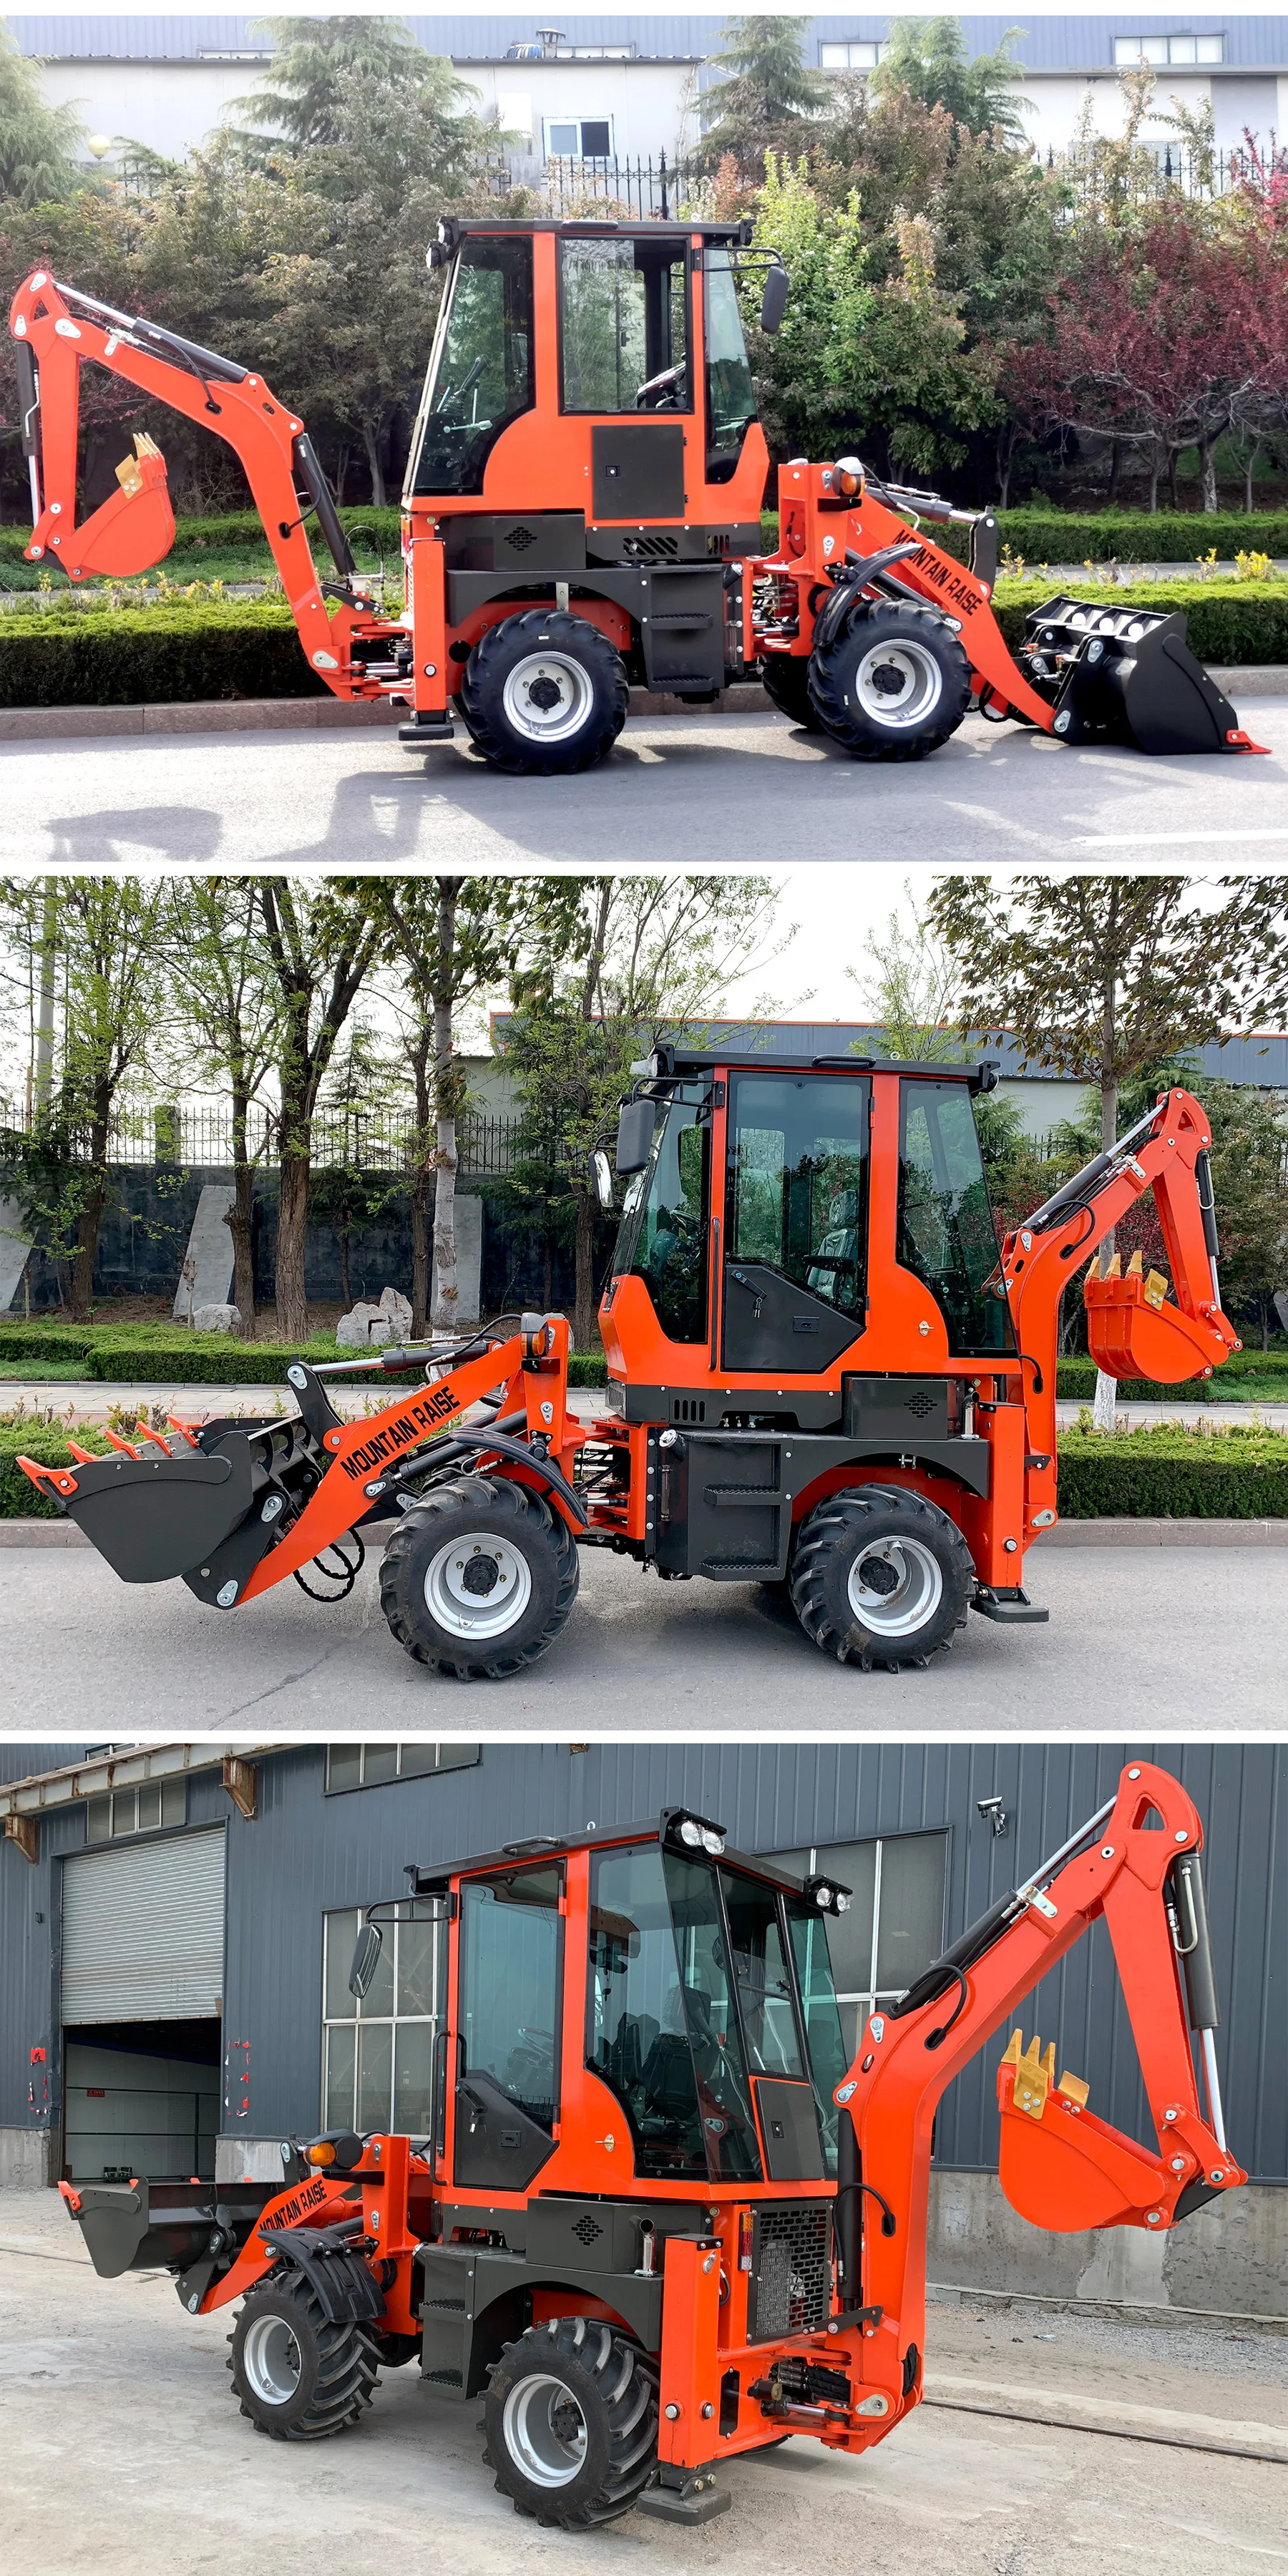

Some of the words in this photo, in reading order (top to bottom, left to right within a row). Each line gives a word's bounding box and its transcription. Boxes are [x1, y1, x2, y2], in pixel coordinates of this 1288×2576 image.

[892, 529, 952, 587] MUNTAIN
[945, 577, 983, 616] RAISE
[340, 1415, 419, 1481] MOUNTAIN
[411, 1385, 461, 1430] RAISE
[298, 2179, 327, 2212] RAISE
